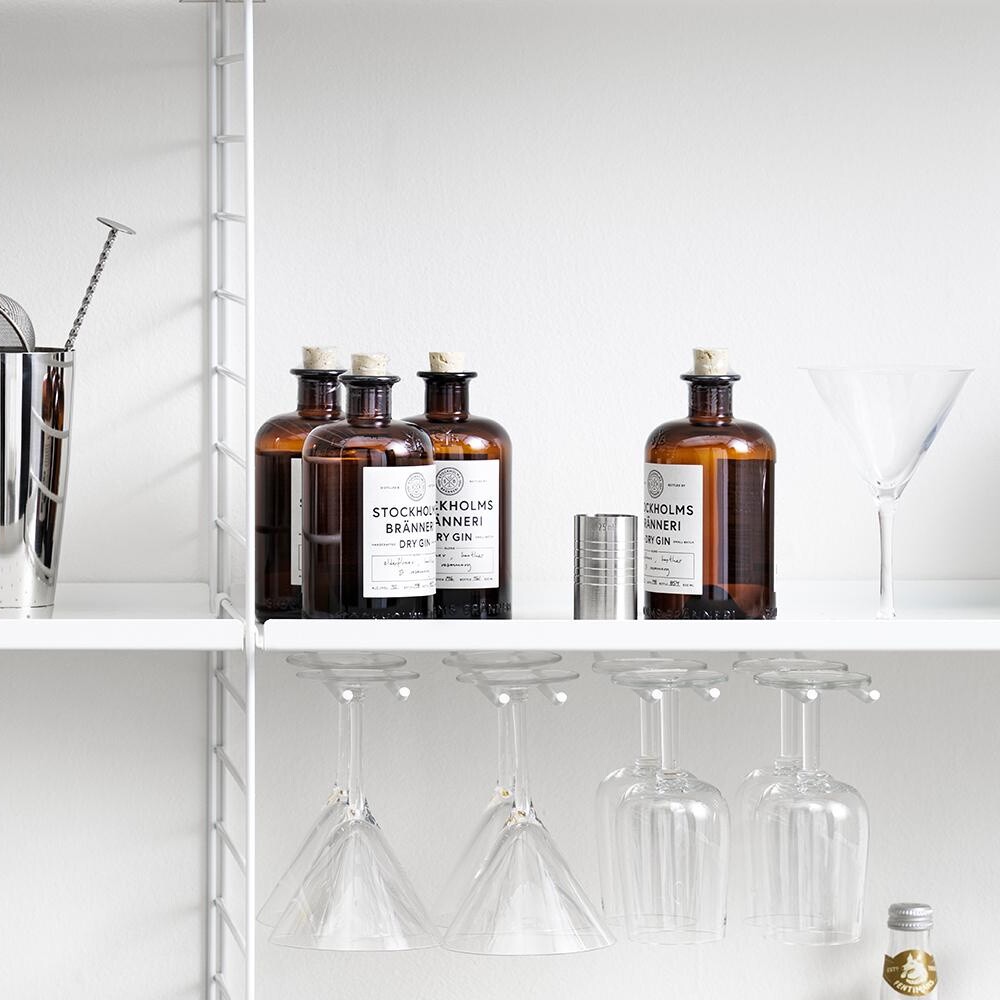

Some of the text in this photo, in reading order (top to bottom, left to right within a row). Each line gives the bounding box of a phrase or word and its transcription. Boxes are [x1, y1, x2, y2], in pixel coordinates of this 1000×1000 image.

[452, 532, 472, 542] GIN
[656, 536, 671, 546] GIN
[399, 539, 417, 549] DRY
[418, 538, 431, 548] GIN
